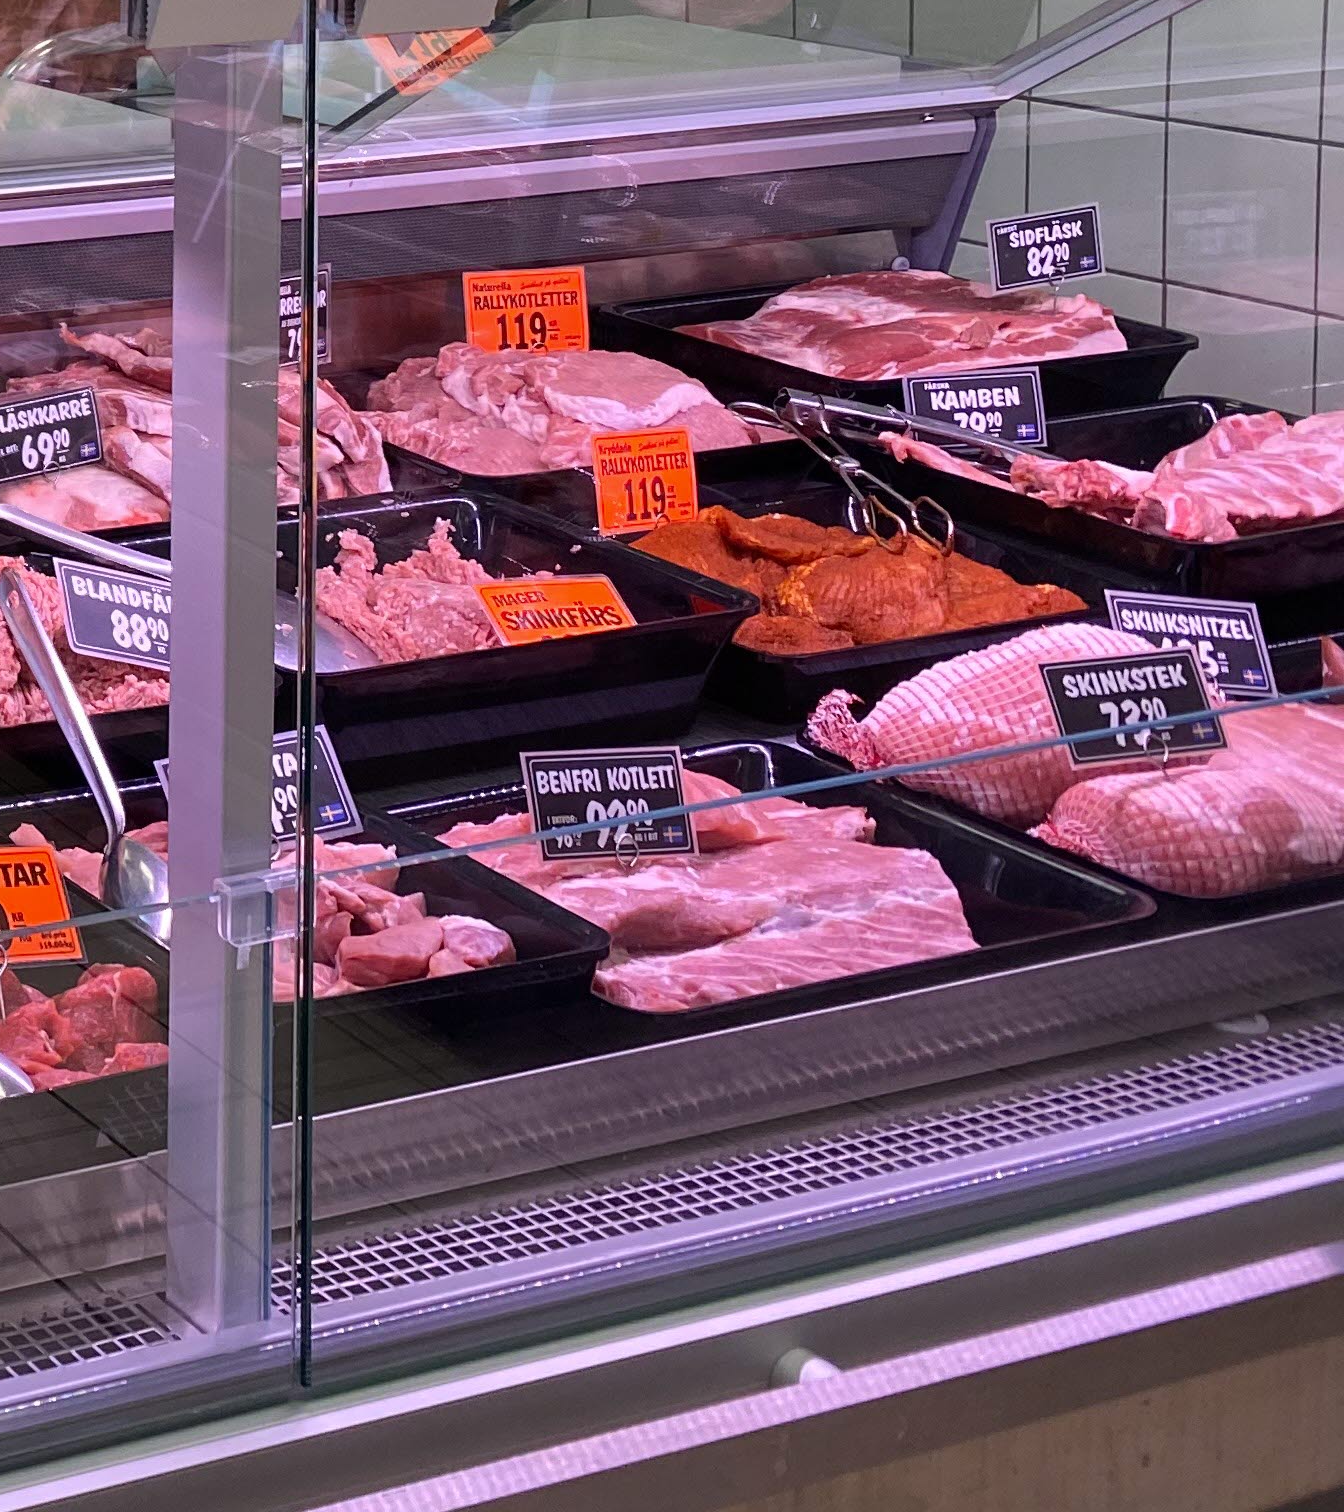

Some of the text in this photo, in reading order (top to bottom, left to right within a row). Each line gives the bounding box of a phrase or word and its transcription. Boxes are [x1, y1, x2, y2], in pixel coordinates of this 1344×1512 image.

[1009, 220, 1084, 248] SIDFLÄSK
[473, 291, 579, 311] RALLYKOTLETTER
[495, 311, 548, 351] 119
[930, 386, 1021, 410] KAMBEN
[601, 451, 689, 476] RALLYKOTLETTER
[491, 591, 547, 607] MAGER
[500, 601, 623, 631] SKINKFÄRS
[1120, 609, 1254, 641] SKINKSNITZEL
[1062, 663, 1188, 699] SKINKSTEK
[535, 764, 675, 795] BENFRI KOTLETT
